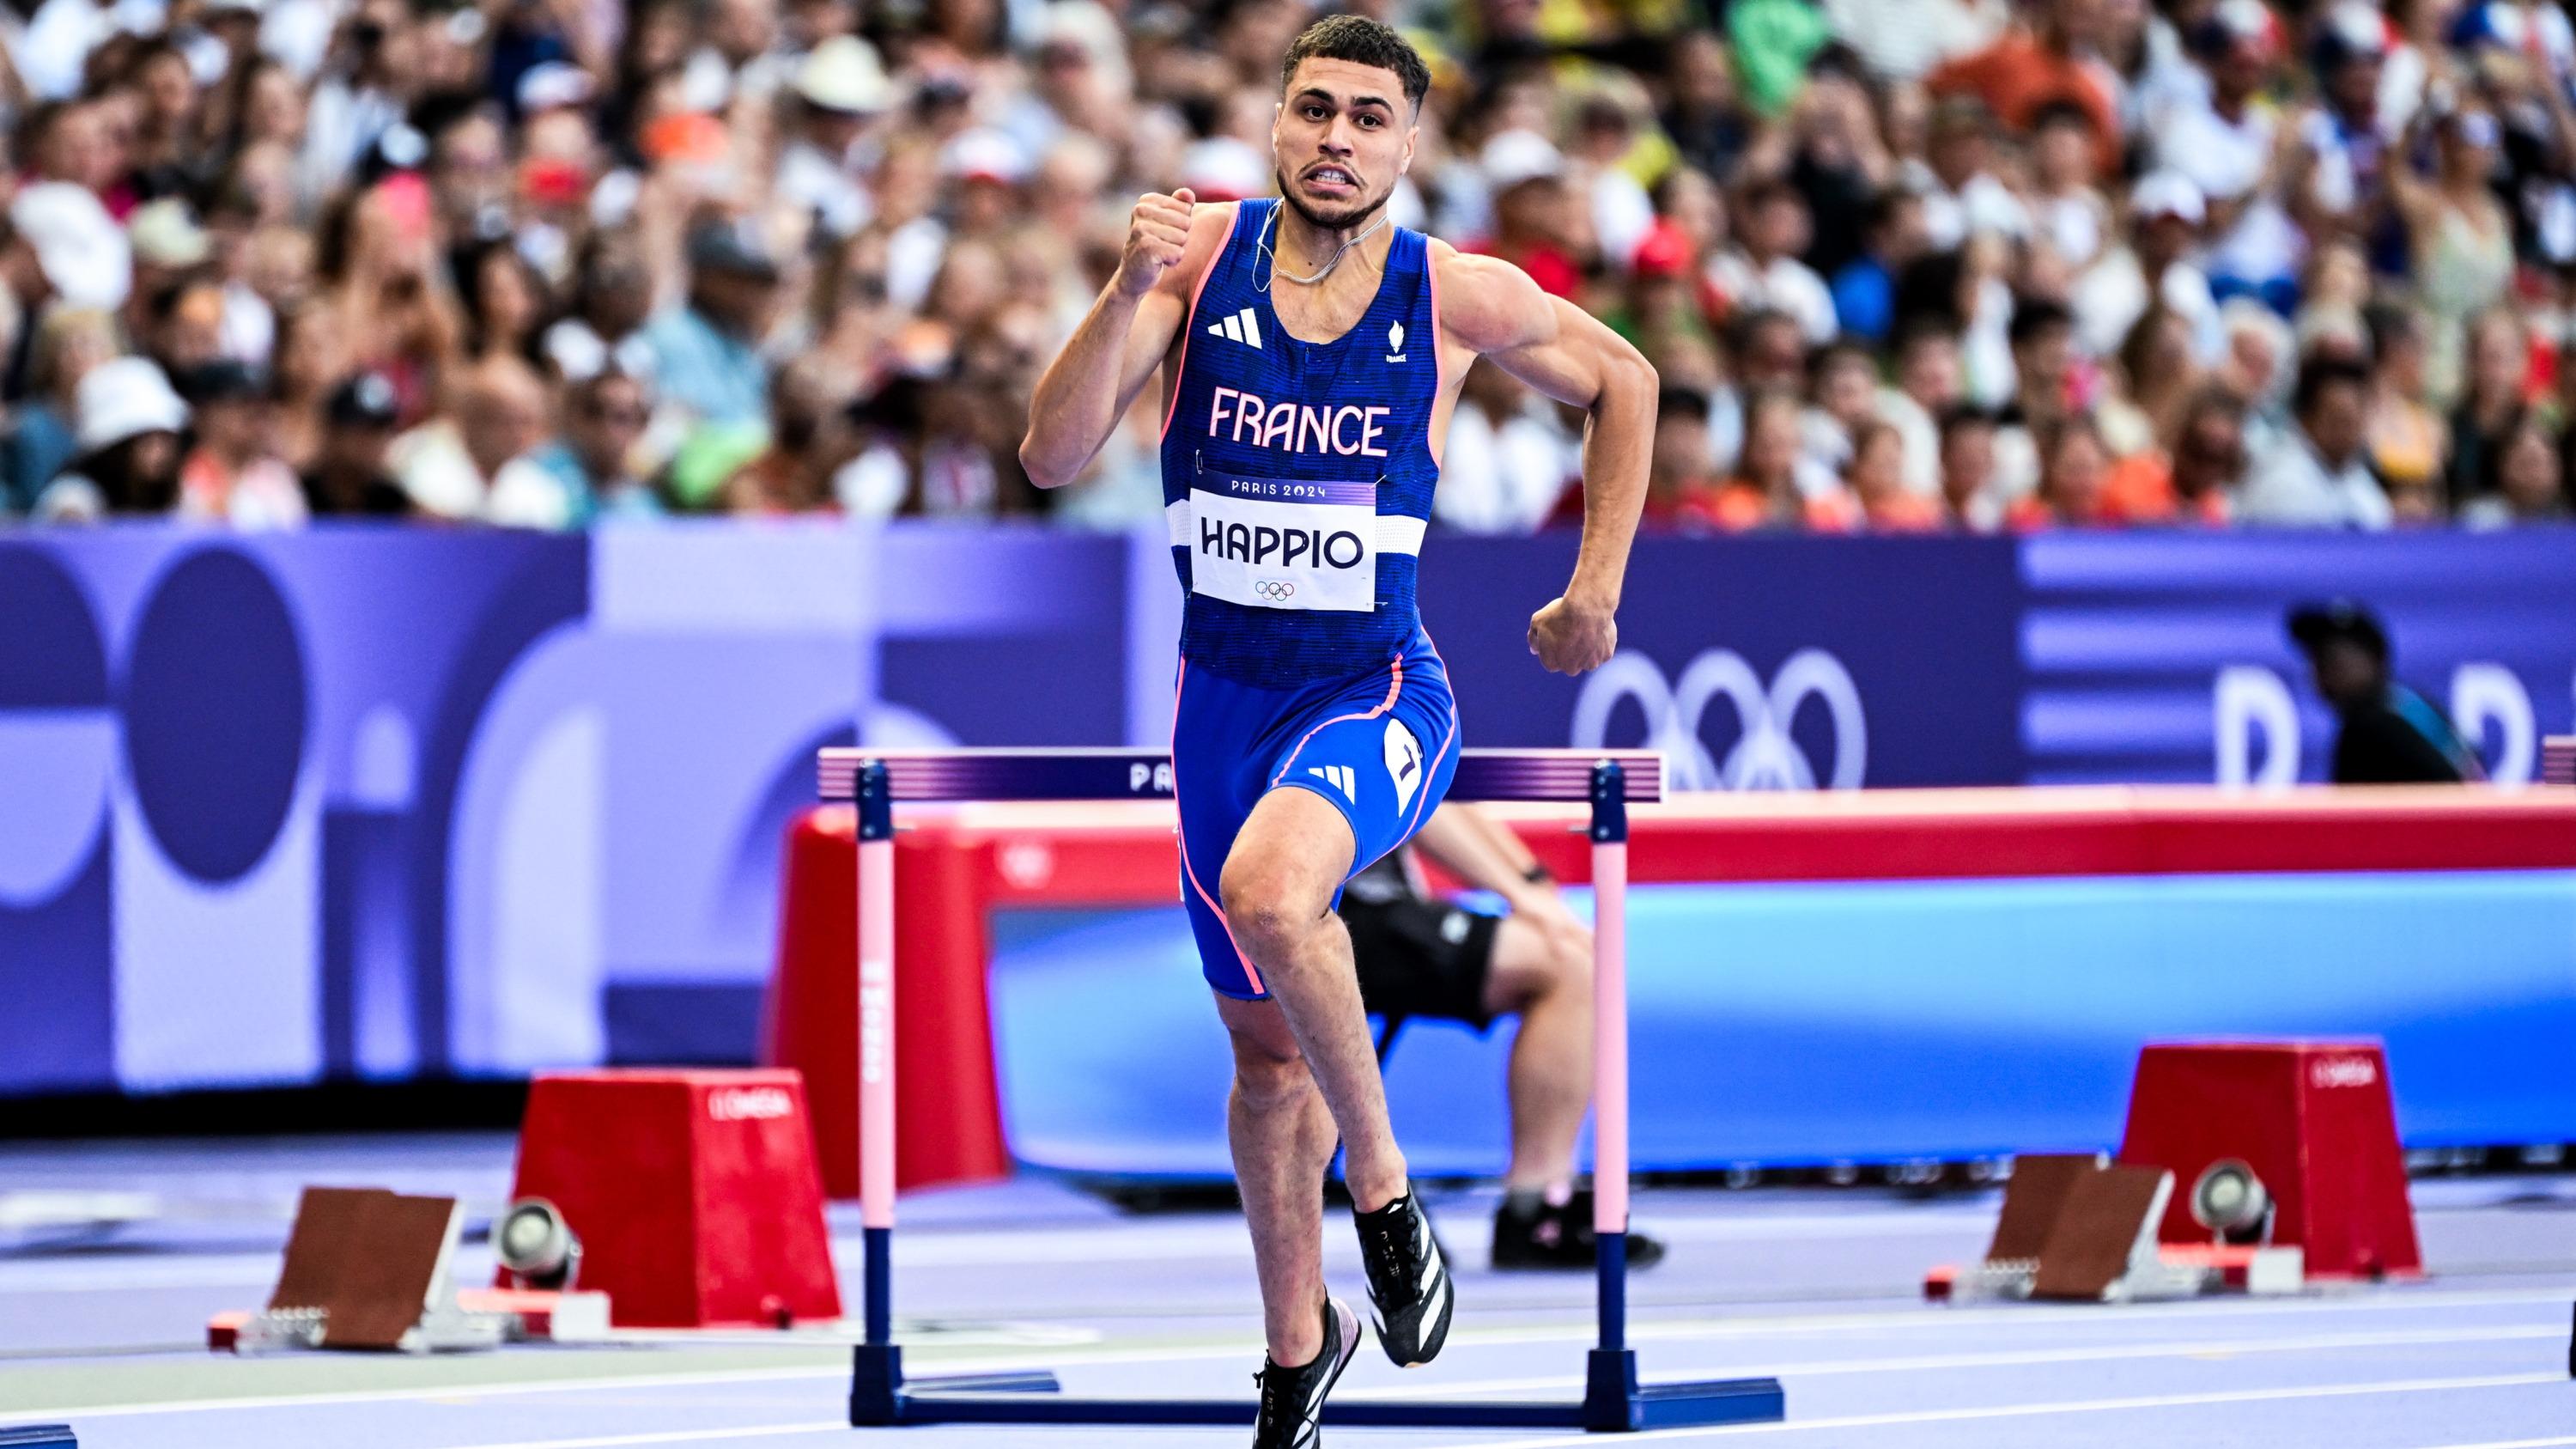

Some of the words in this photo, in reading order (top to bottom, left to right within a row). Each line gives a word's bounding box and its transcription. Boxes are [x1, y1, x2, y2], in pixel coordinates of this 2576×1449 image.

[1209, 386, 1390, 457] FRANCE
[1283, 484, 1326, 497] 2024
[1200, 516, 1364, 569] HAPPIO
